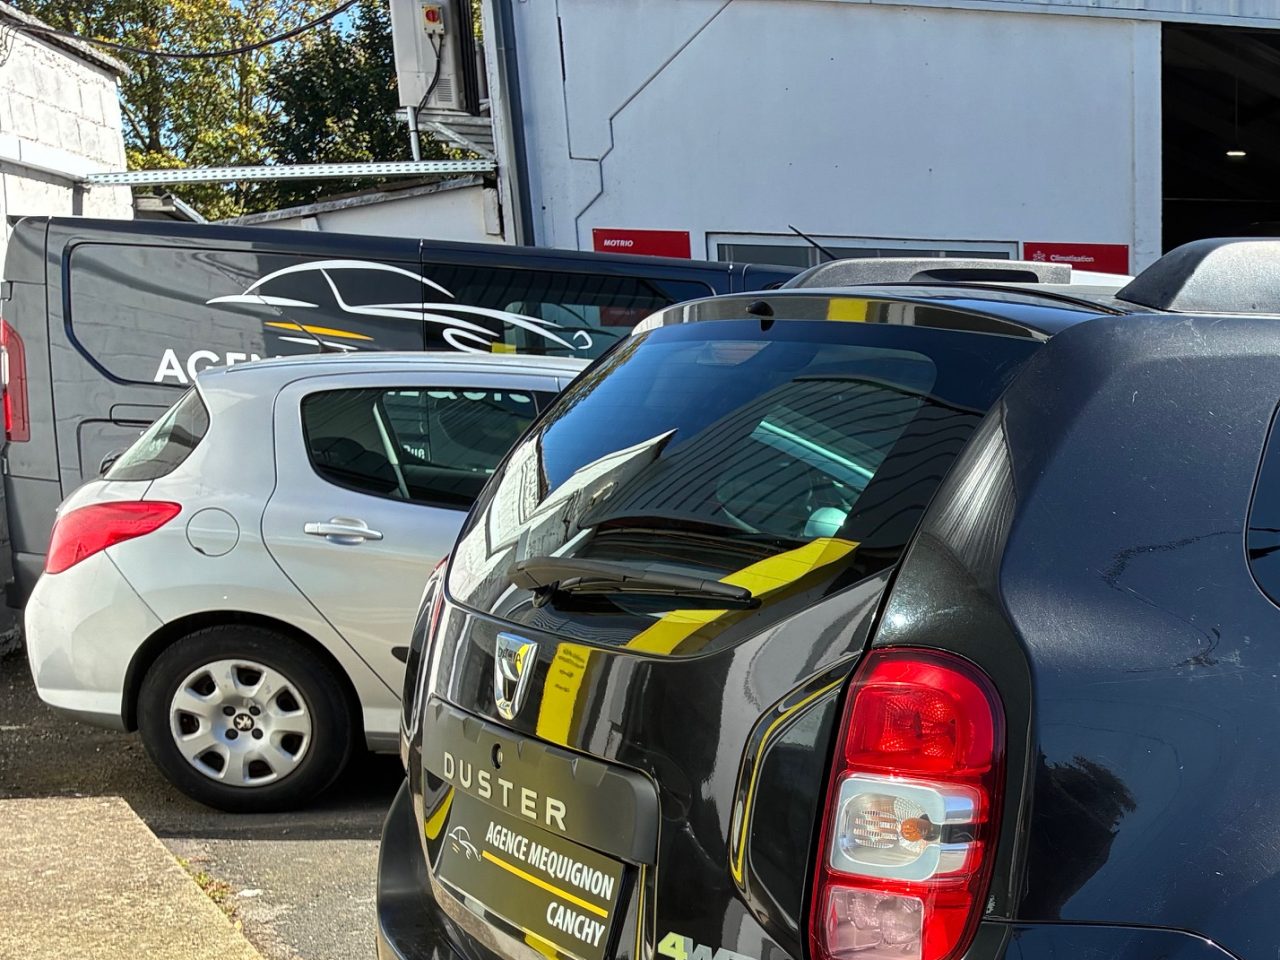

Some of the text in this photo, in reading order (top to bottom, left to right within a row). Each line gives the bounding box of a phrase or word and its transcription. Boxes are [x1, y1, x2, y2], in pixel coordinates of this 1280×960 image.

[603, 239, 634, 247] MOTRIO
[1049, 254, 1095, 263] Climatisation
[443, 751, 567, 832] DUSTER
[485, 821, 615, 901] AGENCE MEQUIGNON
[546, 901, 606, 947] CANCHY
